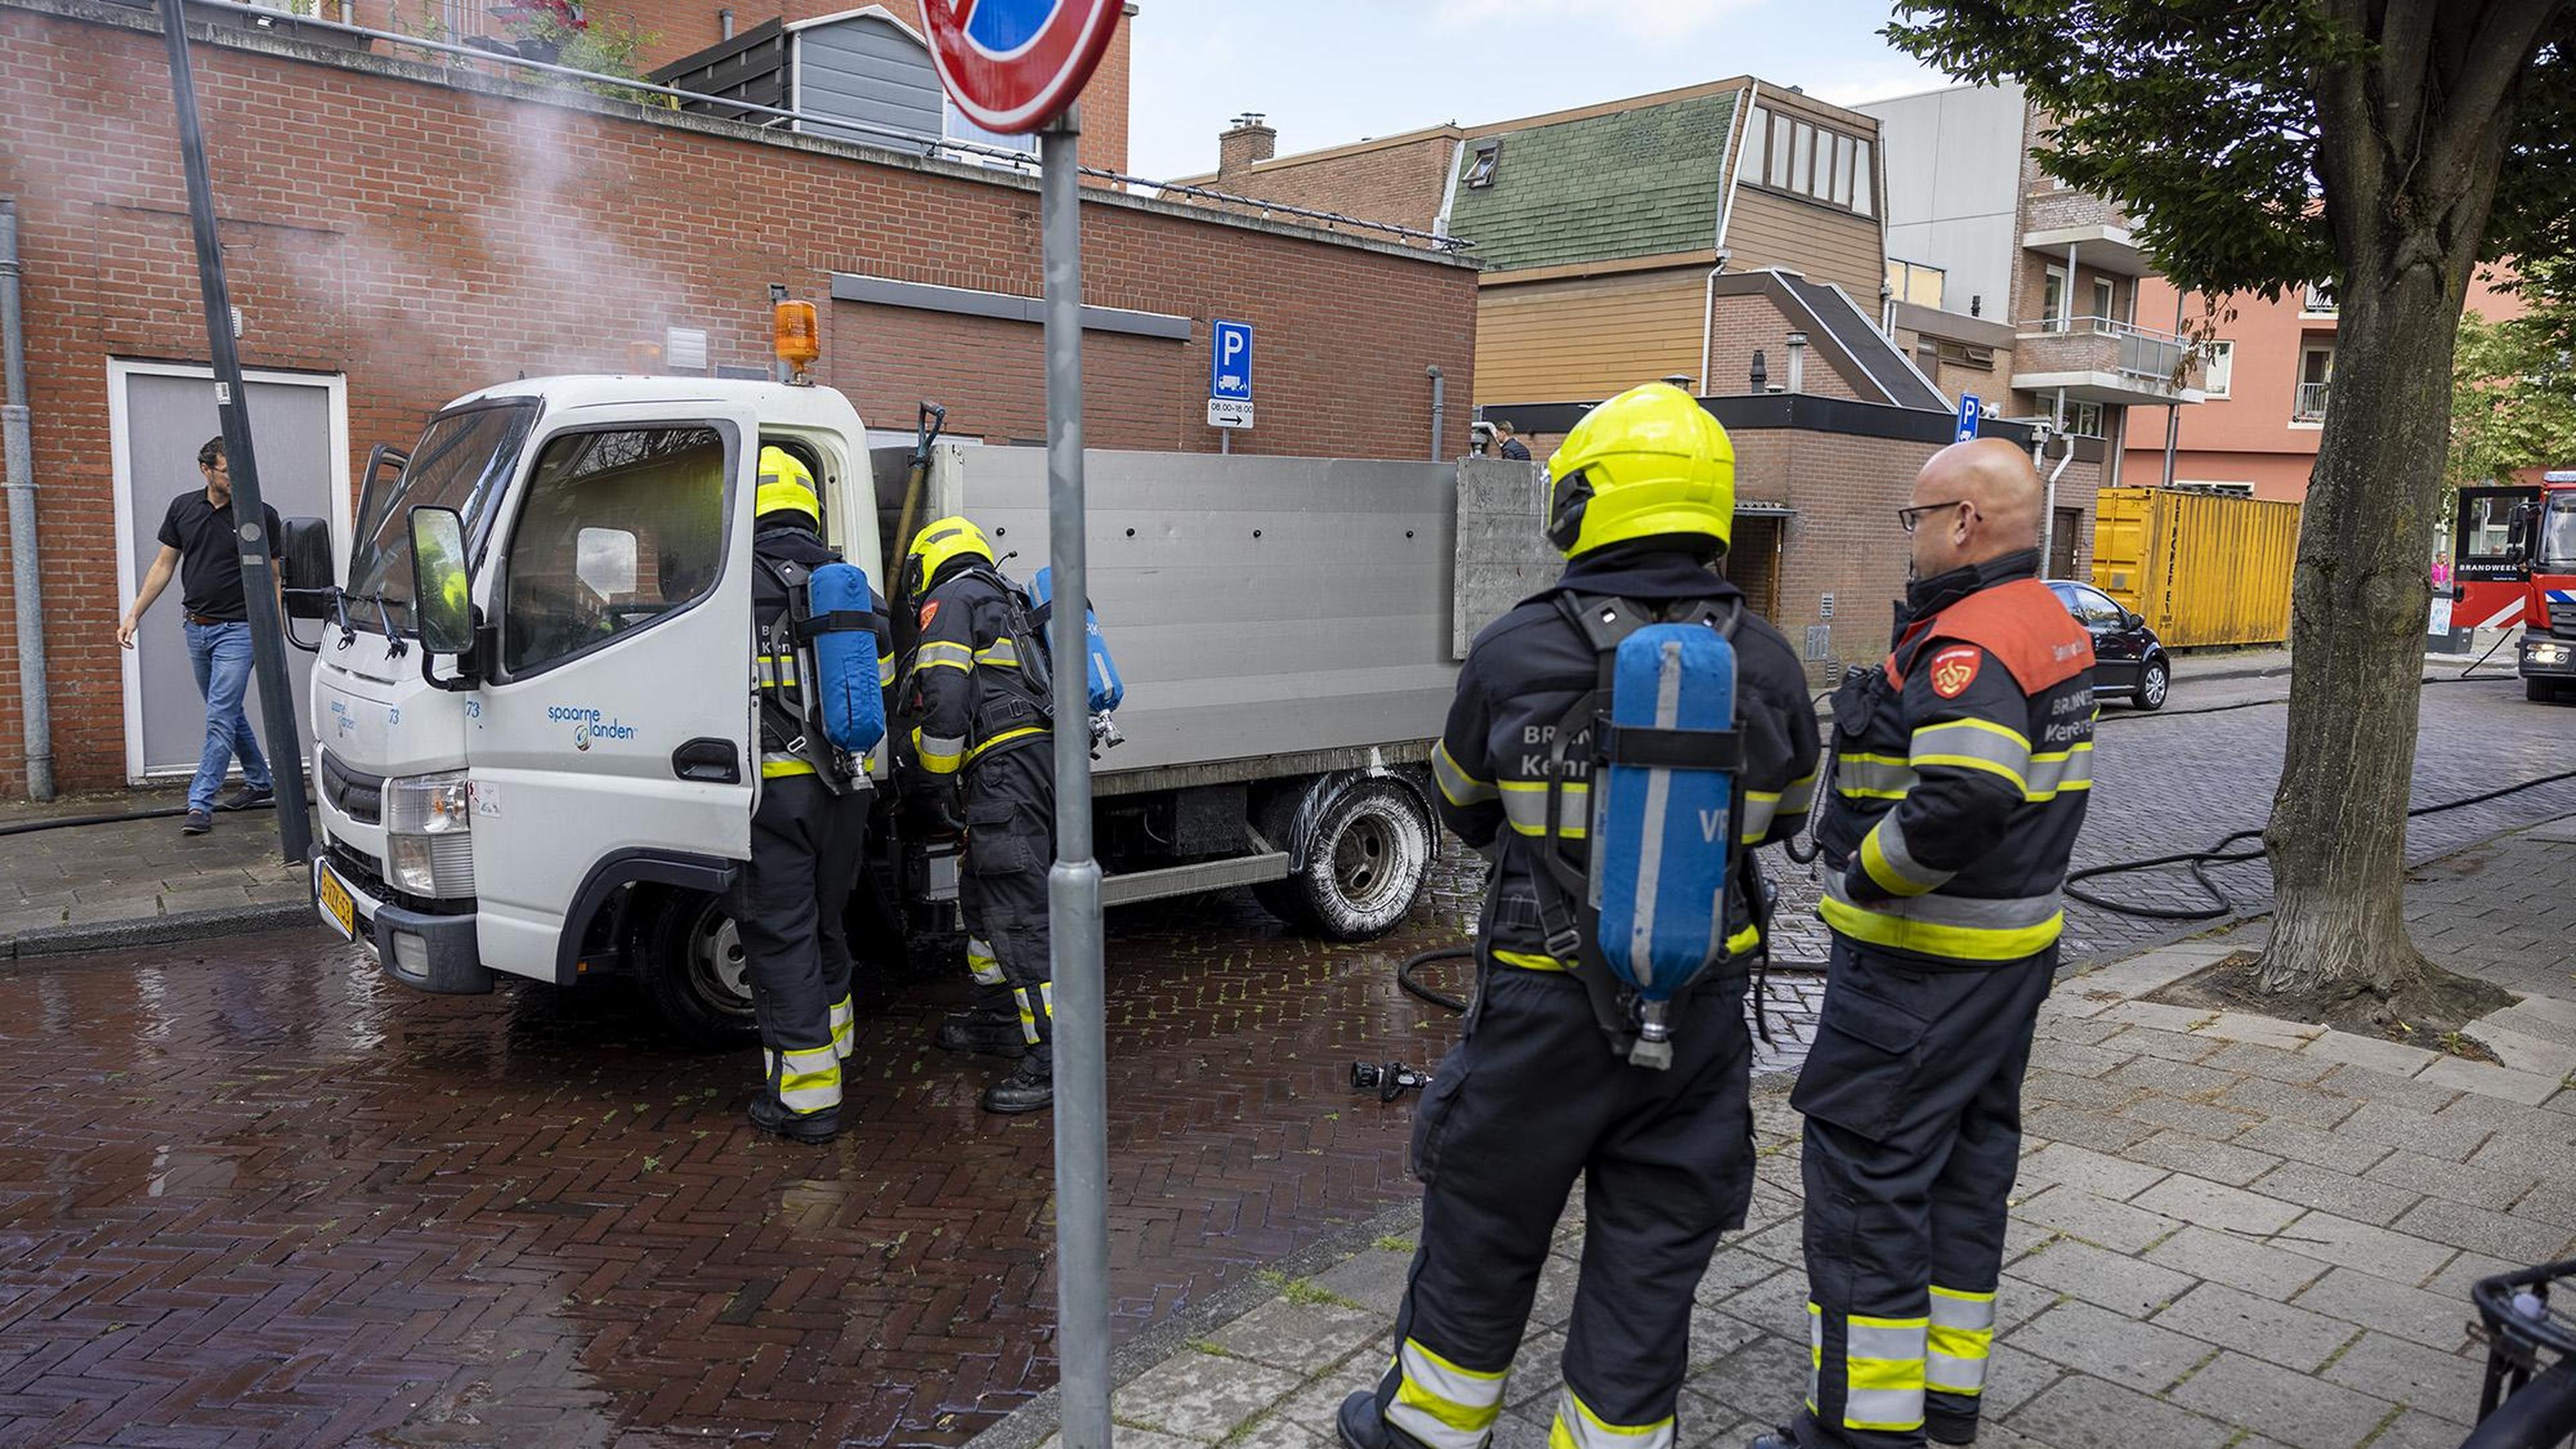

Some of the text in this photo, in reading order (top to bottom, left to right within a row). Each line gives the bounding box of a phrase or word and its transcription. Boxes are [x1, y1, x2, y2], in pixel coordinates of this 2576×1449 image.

[1224, 330, 1244, 366] P
[1964, 400, 1975, 425] P
[389, 708, 400, 724] 73
[467, 701, 480, 718] 73
[548, 706, 600, 723] spaarne
[589, 718, 634, 739] landen
